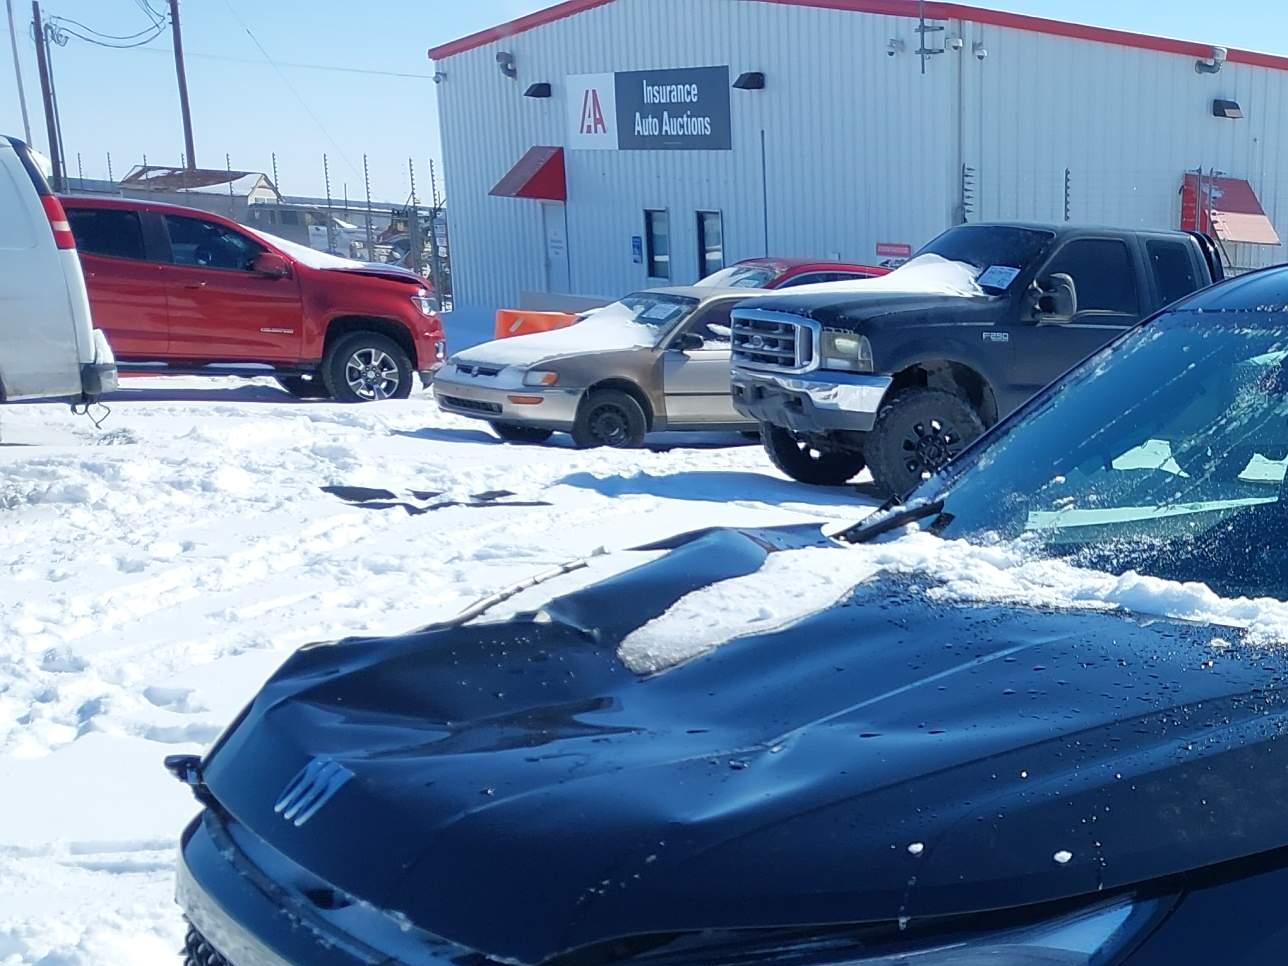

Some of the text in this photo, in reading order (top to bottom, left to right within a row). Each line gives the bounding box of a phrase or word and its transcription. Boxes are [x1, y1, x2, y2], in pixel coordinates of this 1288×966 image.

[642, 79, 698, 104] Insurance
[634, 110, 711, 136] Auto Auctions
